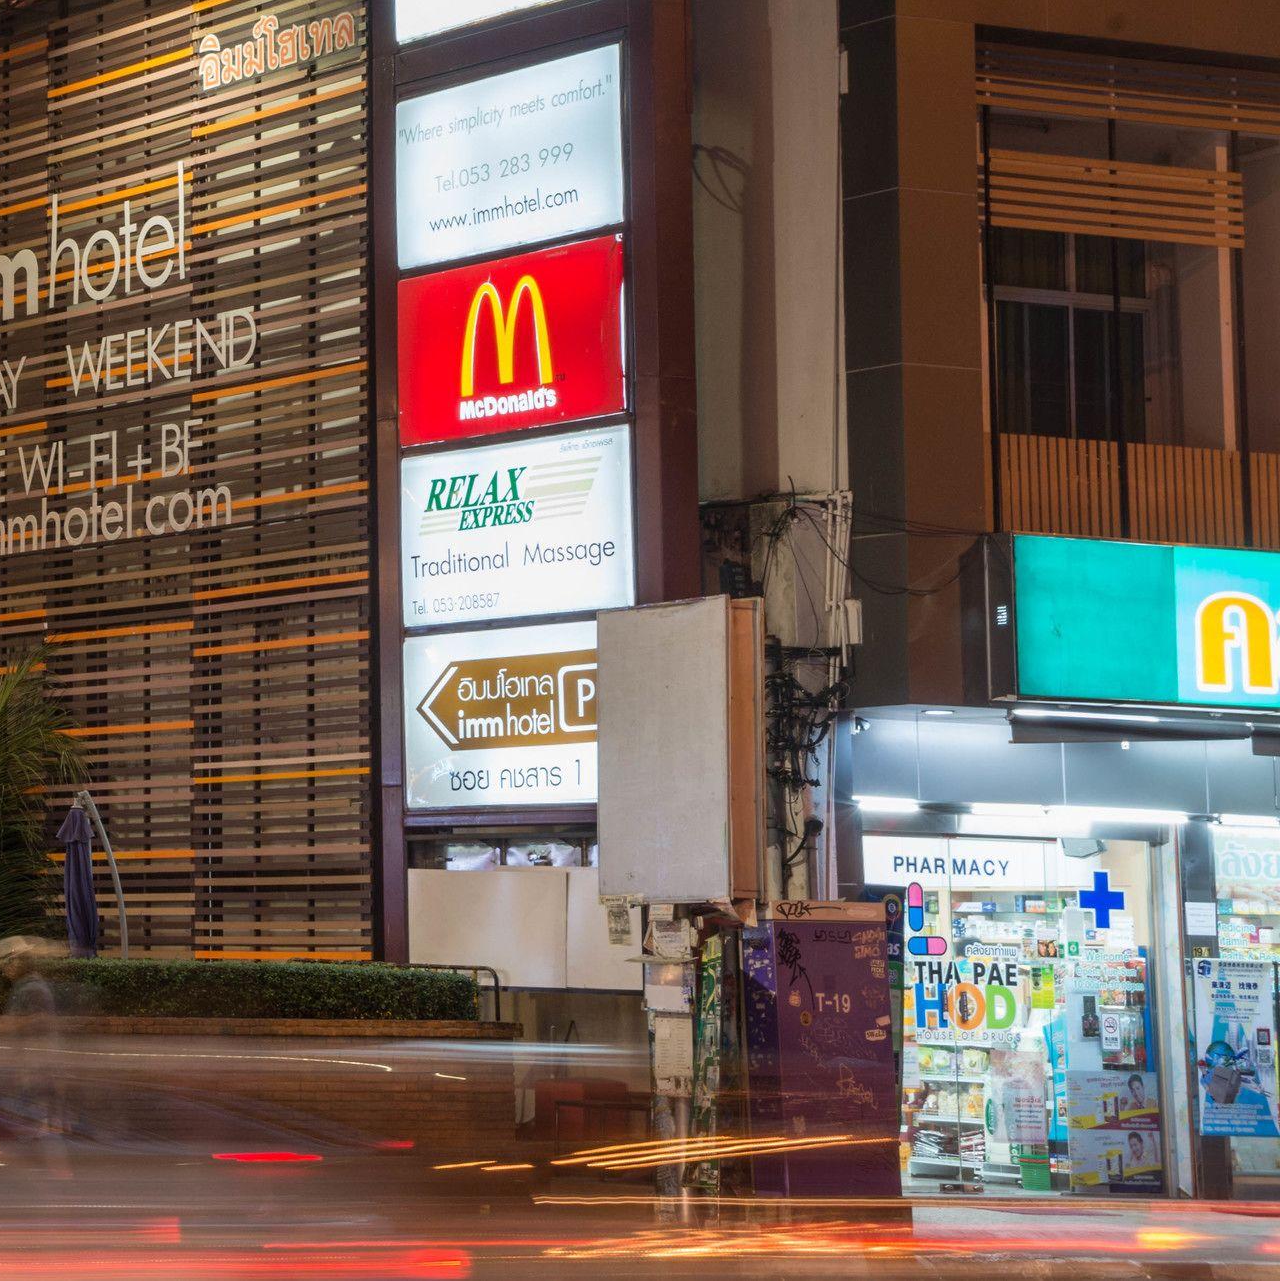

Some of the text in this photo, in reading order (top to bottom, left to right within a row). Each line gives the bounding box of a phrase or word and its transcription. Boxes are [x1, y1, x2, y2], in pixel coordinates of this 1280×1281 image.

[448, 106, 504, 137] simplicity
[510, 95, 547, 117] meets
[499, 152, 531, 178] 283
[538, 142, 575, 169] 999
[428, 187, 579, 232] www.immhotel.com
[65, 307, 258, 397] WEEKEND
[459, 385, 558, 421] McDonald's
[18, 430, 118, 496] WI-FI
[424, 465, 527, 514] RELAX
[457, 499, 536, 532] EXPRESS
[410, 537, 616, 580] Traditional Massage
[412, 599, 429, 616] Tel.
[577, 677, 596, 707] P
[450, 759, 582, 792] ซอย คชสาร 1
[893, 855, 1010, 877] PHARMACY
[1086, 950, 1130, 962] Welcome
[1218, 936, 1249, 948] itamin
[973, 961, 1018, 987] PAE
[815, 992, 851, 1014] T-19
[915, 983, 1017, 1031] HOD
[916, 1032, 953, 1041] HOUSE
[983, 1031, 1021, 1042] DRUGS
